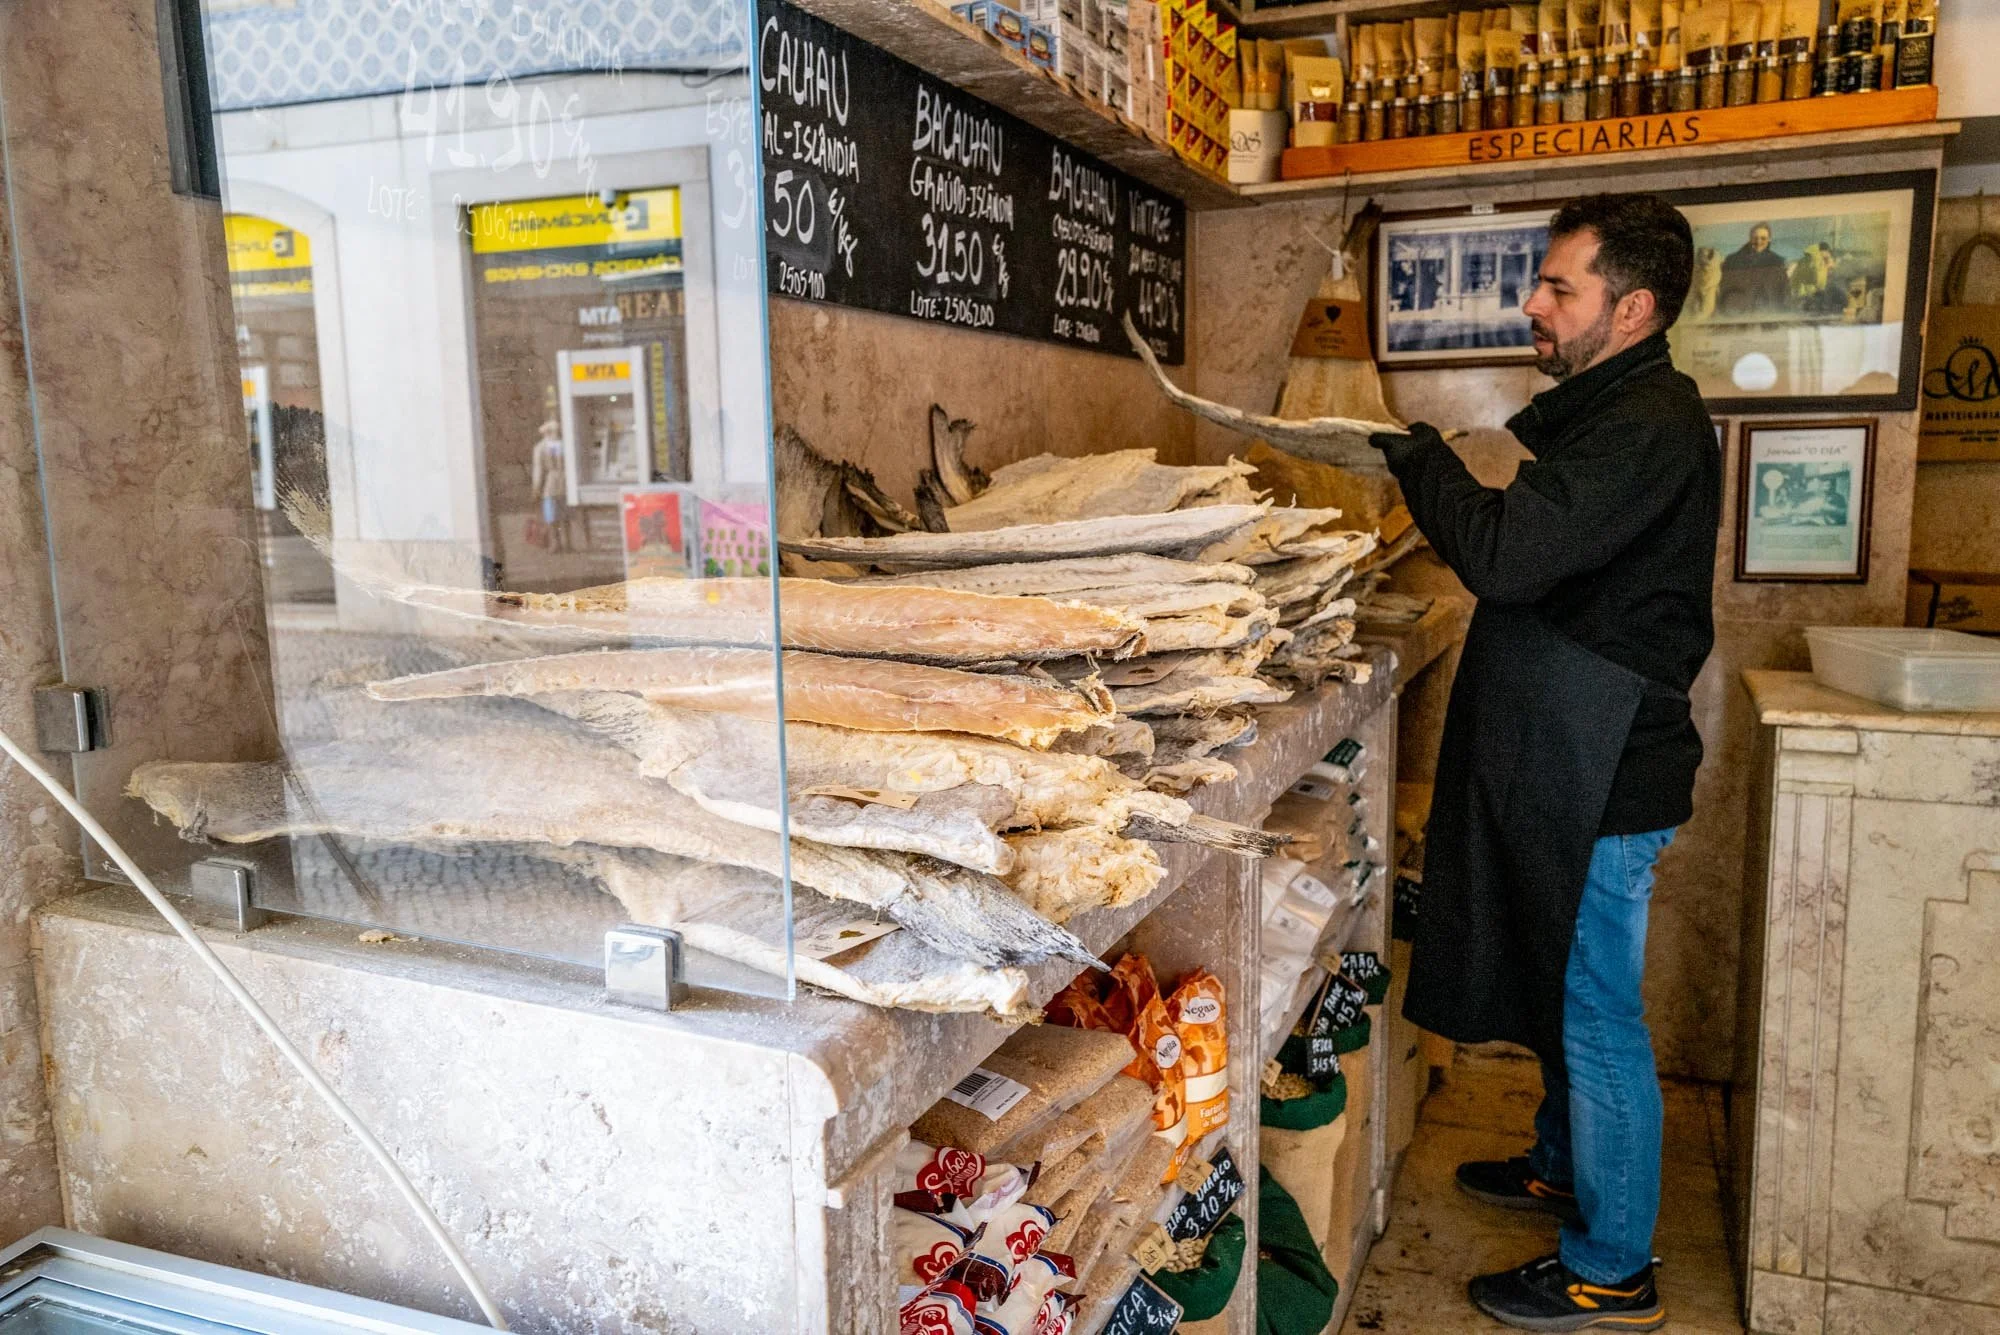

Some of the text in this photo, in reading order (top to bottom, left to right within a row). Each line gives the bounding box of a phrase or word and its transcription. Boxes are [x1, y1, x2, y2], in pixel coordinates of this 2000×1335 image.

[912, 84, 1003, 176] BACALHAU
[1468, 116, 1700, 161] ESPECIARIAS
[1049, 145, 1117, 225] BACALHAU
